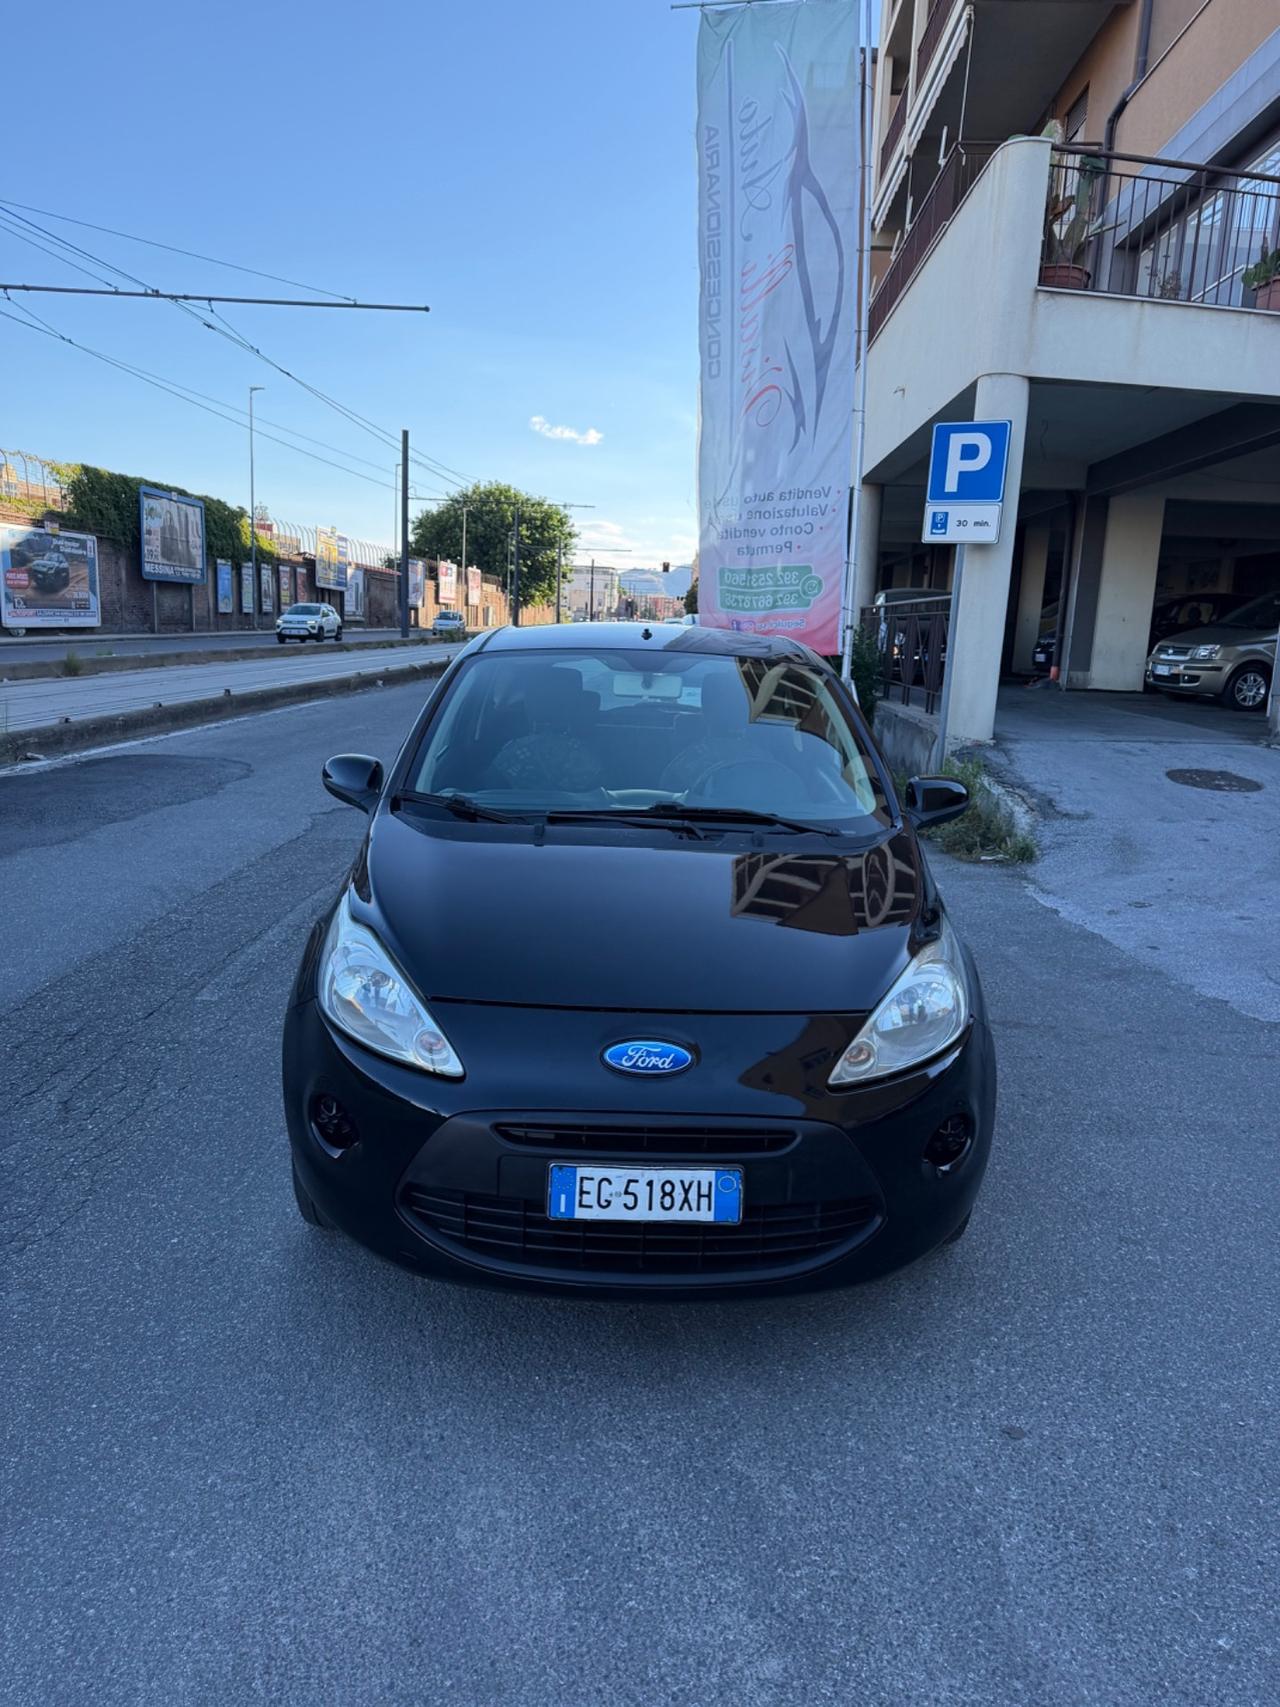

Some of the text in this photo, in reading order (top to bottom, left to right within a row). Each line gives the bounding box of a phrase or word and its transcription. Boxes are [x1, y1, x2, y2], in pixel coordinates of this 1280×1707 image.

[944, 432, 993, 493] P
[956, 519, 991, 527] 30 min.
[621, 1045, 675, 1069] Ford
